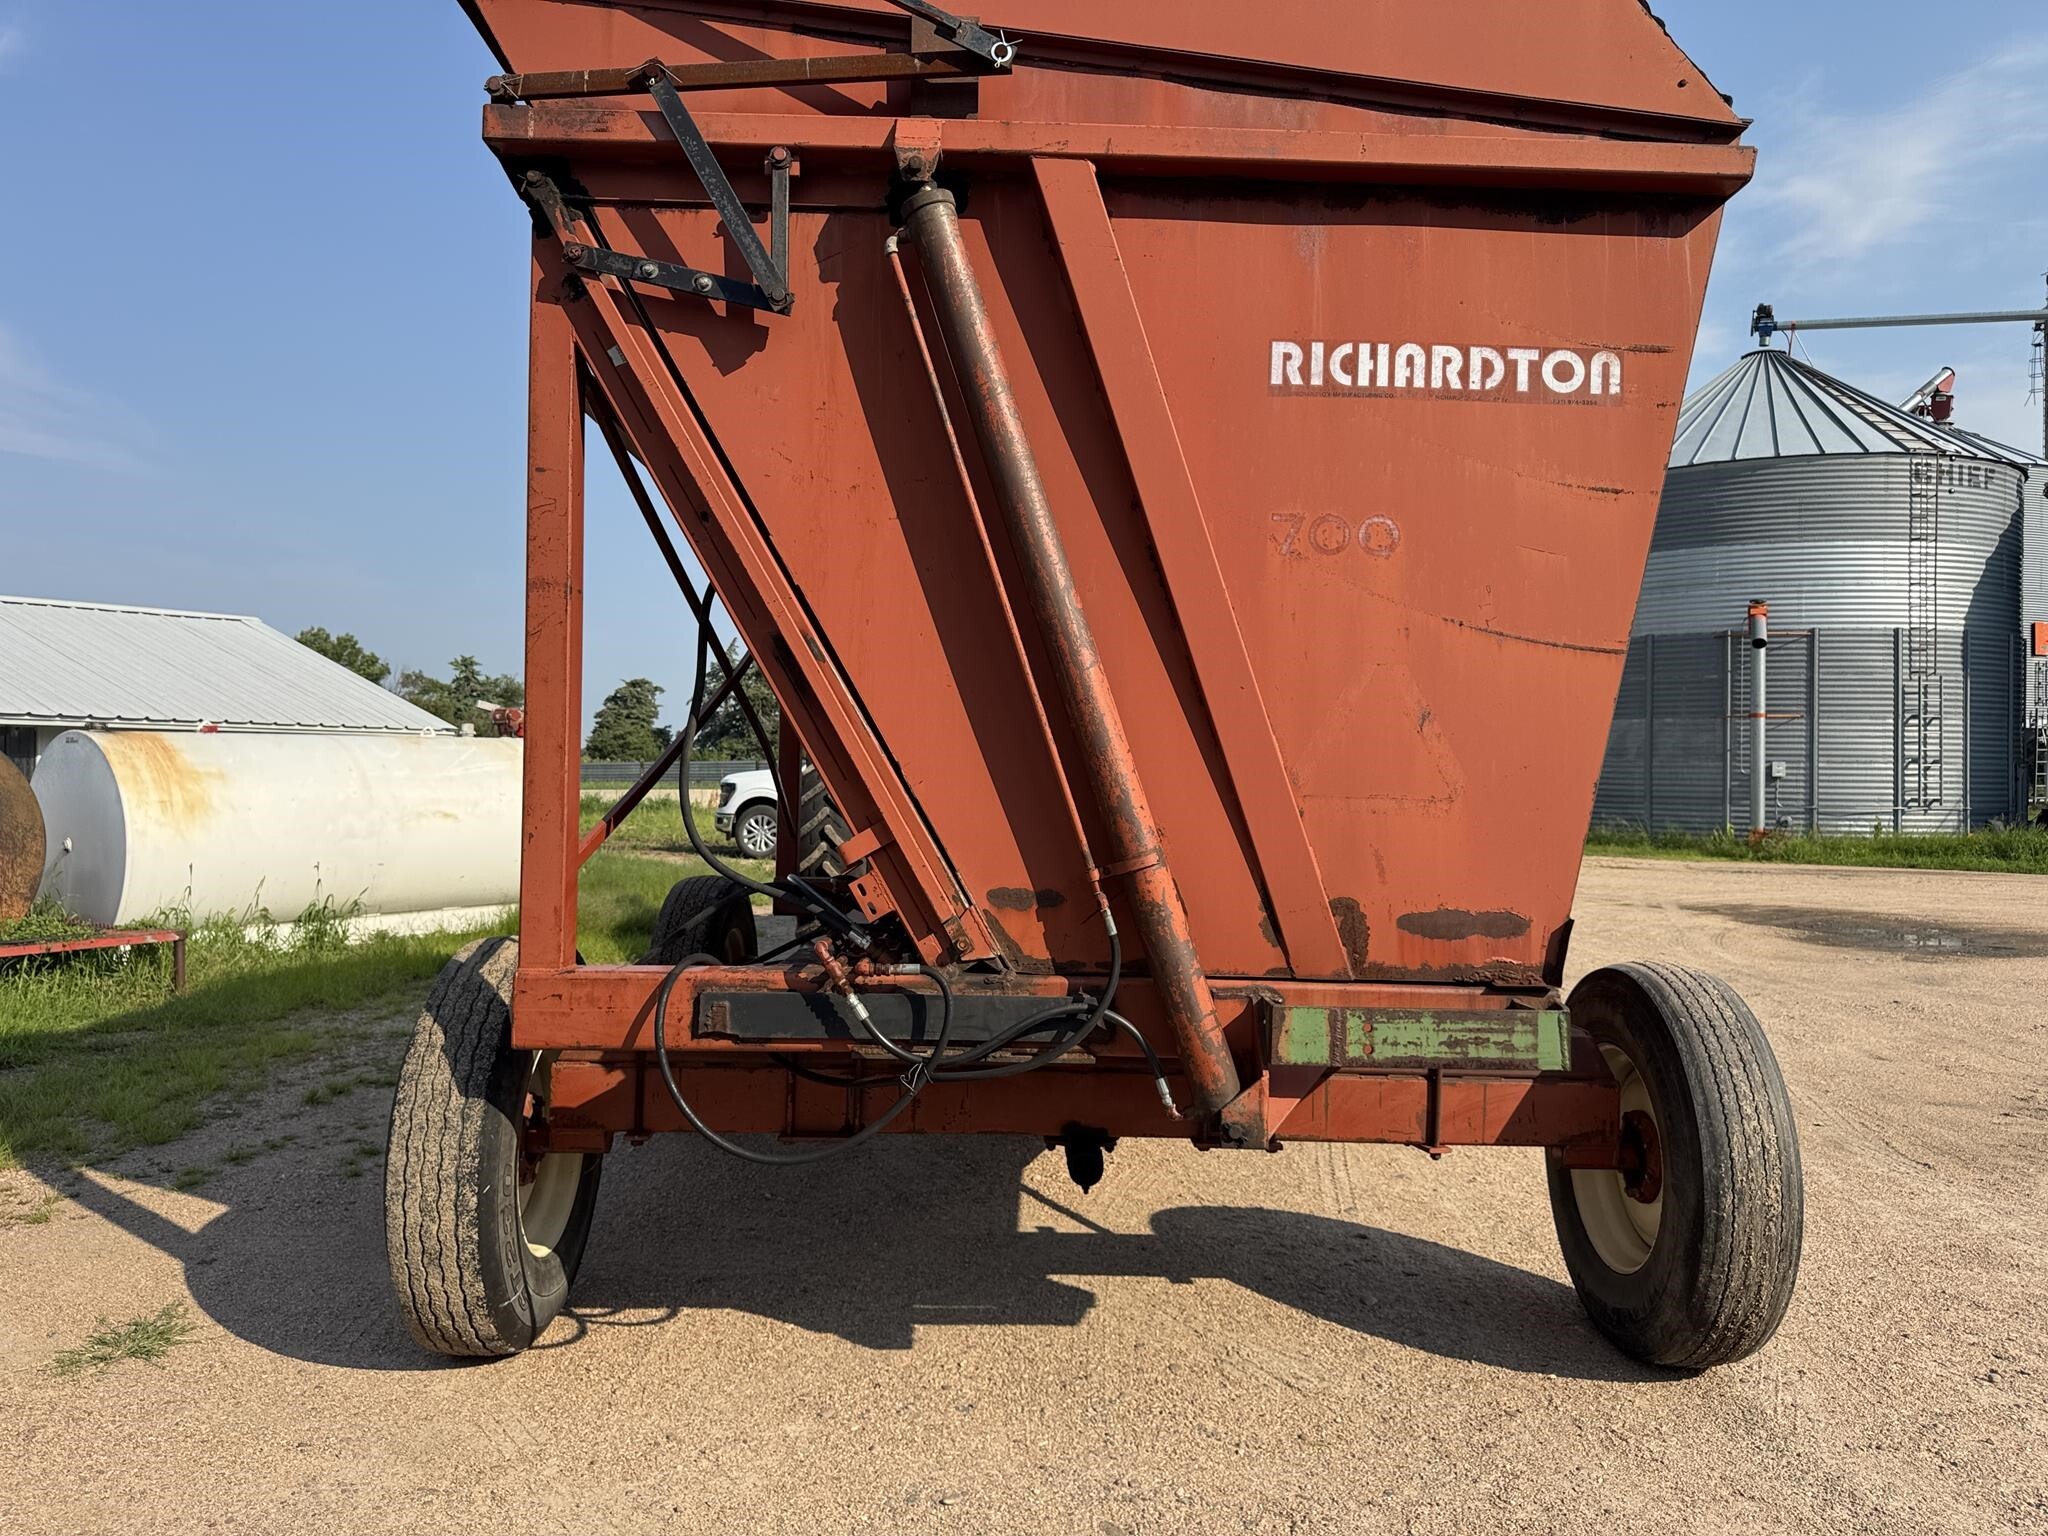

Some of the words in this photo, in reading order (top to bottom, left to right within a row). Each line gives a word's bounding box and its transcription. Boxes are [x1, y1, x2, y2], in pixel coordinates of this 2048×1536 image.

[1270, 341, 1621, 395] RICHARDTON
[1914, 461, 1996, 490] CHIEF
[1271, 512, 1400, 558] 700
